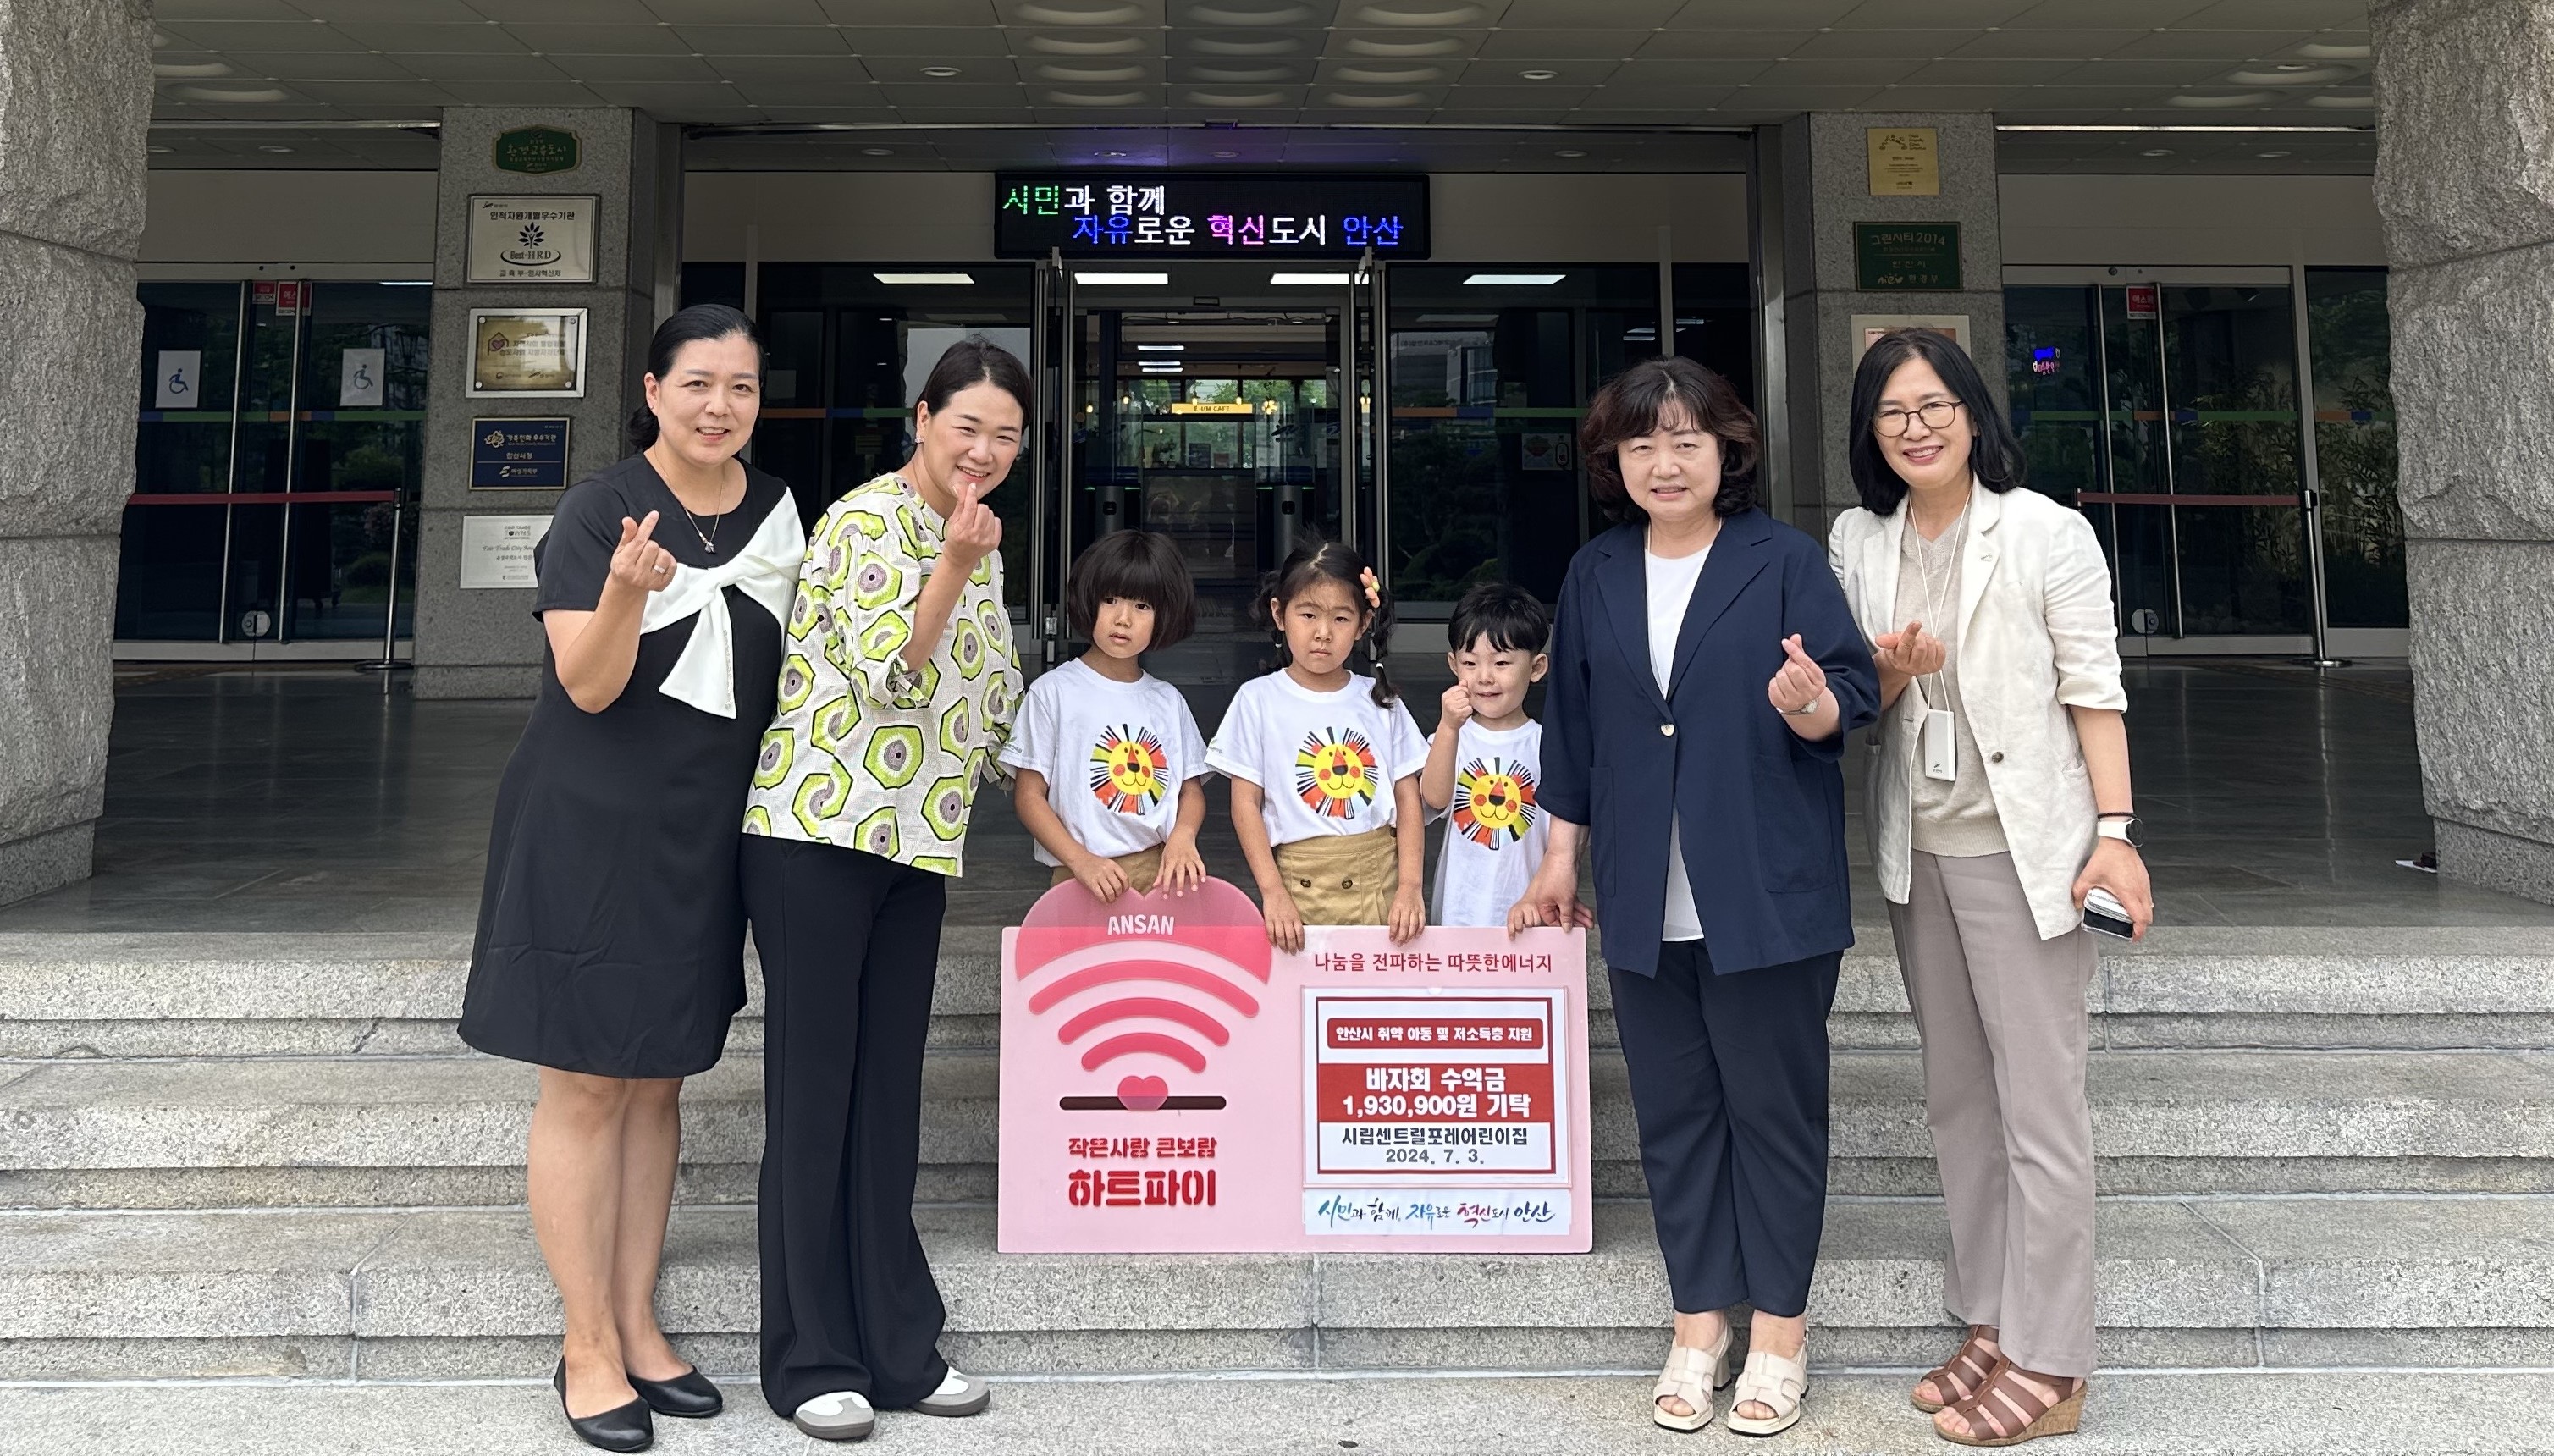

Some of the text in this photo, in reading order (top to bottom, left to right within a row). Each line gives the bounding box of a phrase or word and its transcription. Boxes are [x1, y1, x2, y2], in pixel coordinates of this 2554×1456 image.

[1002, 185, 1166, 215] 시민과 함께
[490, 211, 575, 221] 인적자원개발우수기관
[1072, 214, 1404, 245] 자유로운 혁신도시 안산
[1107, 914, 1175, 935] ANSAN
[1315, 953, 1553, 973] 나눔을 전파하는 따뜻한에너지
[1336, 1026, 1533, 1042] 안산시 취약 아동 및 저소득층 지원
[1366, 1067, 1507, 1093] 바자회 수익금
[1343, 1094, 1531, 1118] 1,930,900원 기탁
[1068, 1136, 1218, 1158] 작은사랑 큰보람
[1342, 1128, 1528, 1146] 시립센트럴포레어린이집
[1386, 1149, 1485, 1165] 2024. 7. 3.
[1068, 1169, 1216, 1207] 하트파이
[1318, 1195, 1366, 1228] 시민과
[1404, 1202, 1451, 1230] 자유로운
[1456, 1202, 1509, 1228] 혁신도시
[1514, 1201, 1556, 1223] 안산
